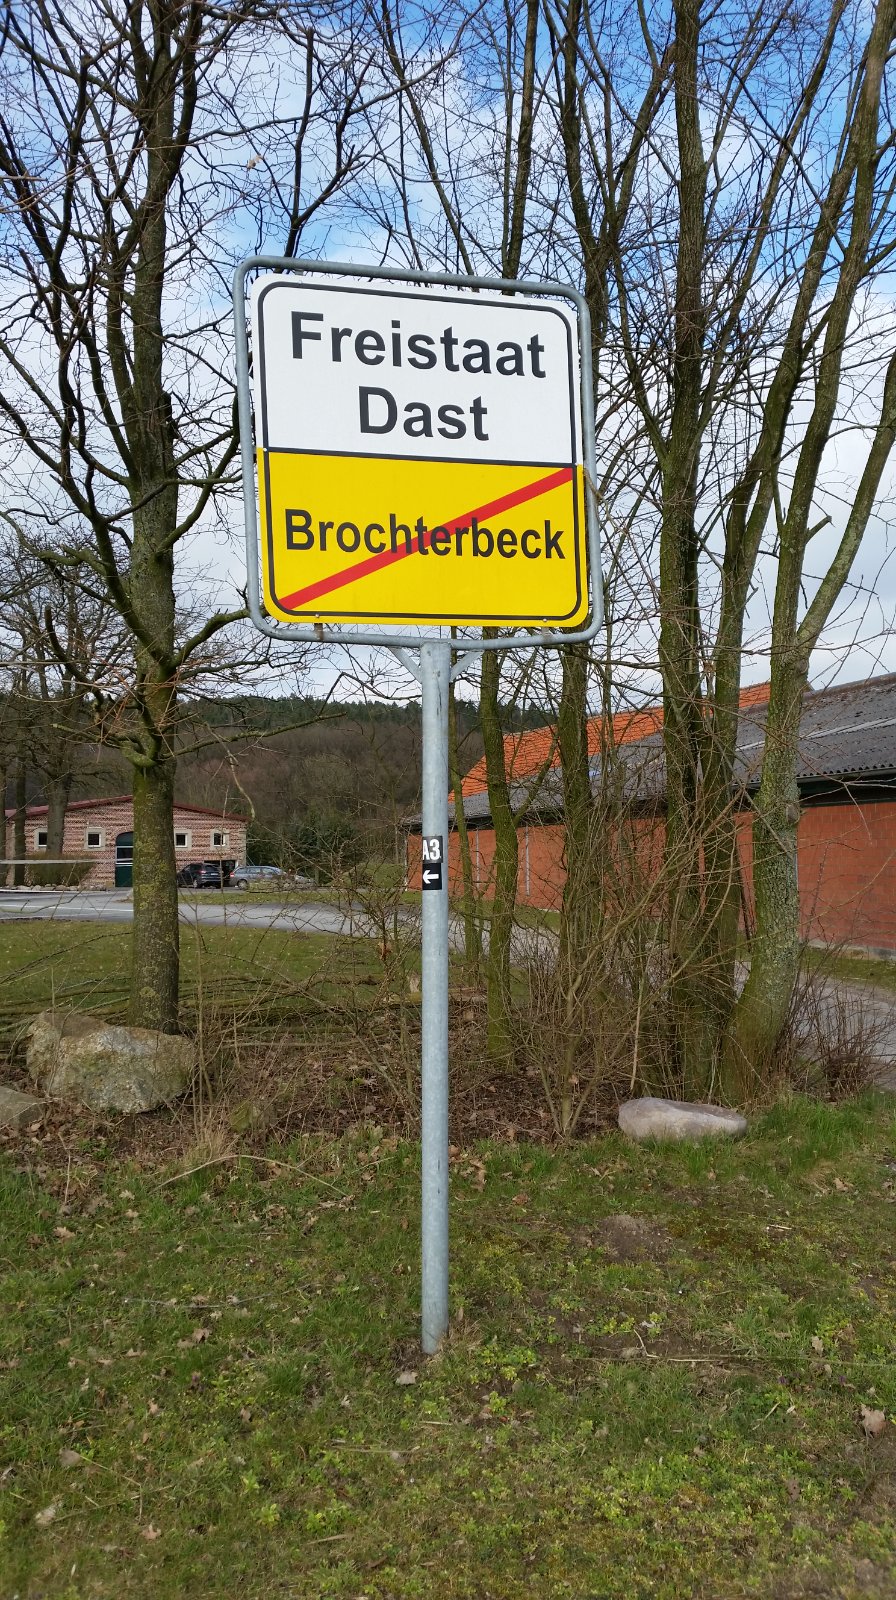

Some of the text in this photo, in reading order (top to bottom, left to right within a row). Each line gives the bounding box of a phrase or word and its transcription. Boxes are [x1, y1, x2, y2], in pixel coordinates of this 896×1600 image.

[291, 311, 546, 378] Freistaat
[358, 386, 489, 441] Dast
[285, 508, 566, 560] Brochterbeck
[422, 838, 441, 861] A3
